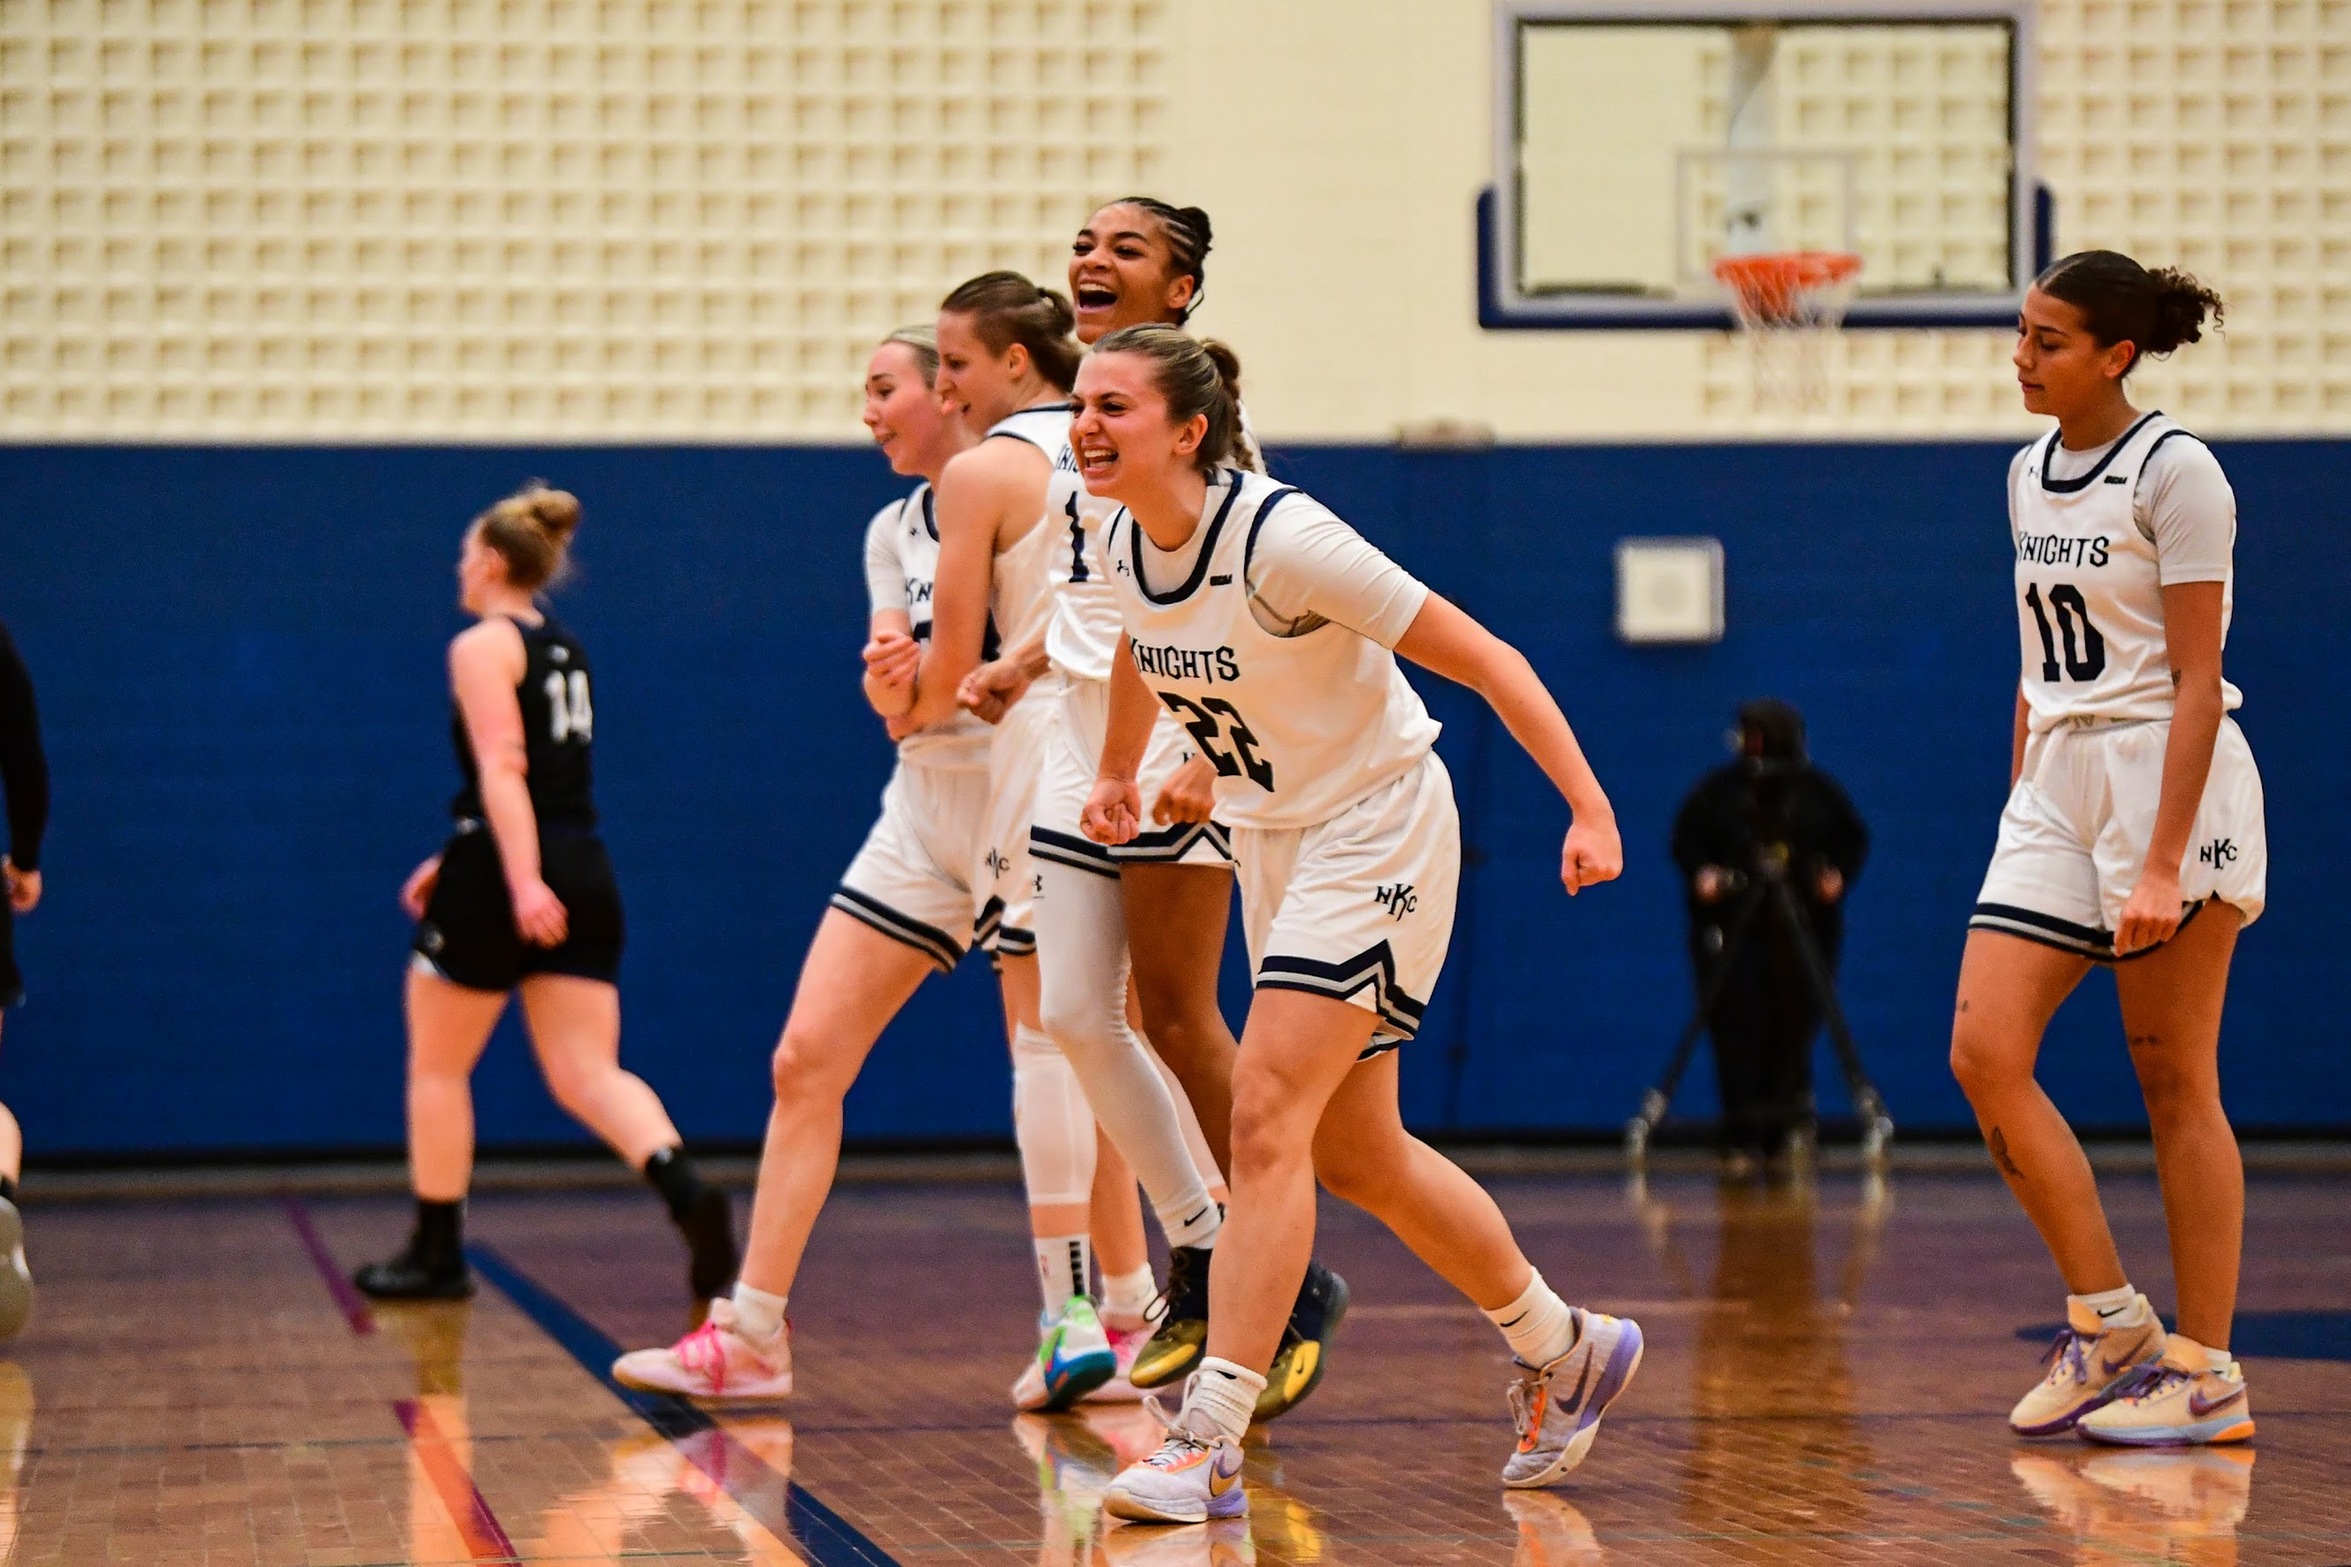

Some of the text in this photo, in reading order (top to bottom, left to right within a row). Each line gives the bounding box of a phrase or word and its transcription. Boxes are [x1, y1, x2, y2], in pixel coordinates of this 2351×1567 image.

[1065, 491, 1089, 583] 1
[2019, 532, 2109, 568] KNIGHTS
[1129, 635, 1240, 684] KNIGHTS
[2025, 582, 2106, 683] 10
[543, 669, 593, 744] 14
[1157, 691, 1275, 792] 22
[2200, 837, 2237, 870] NKC
[1374, 883, 1418, 922] NKC
